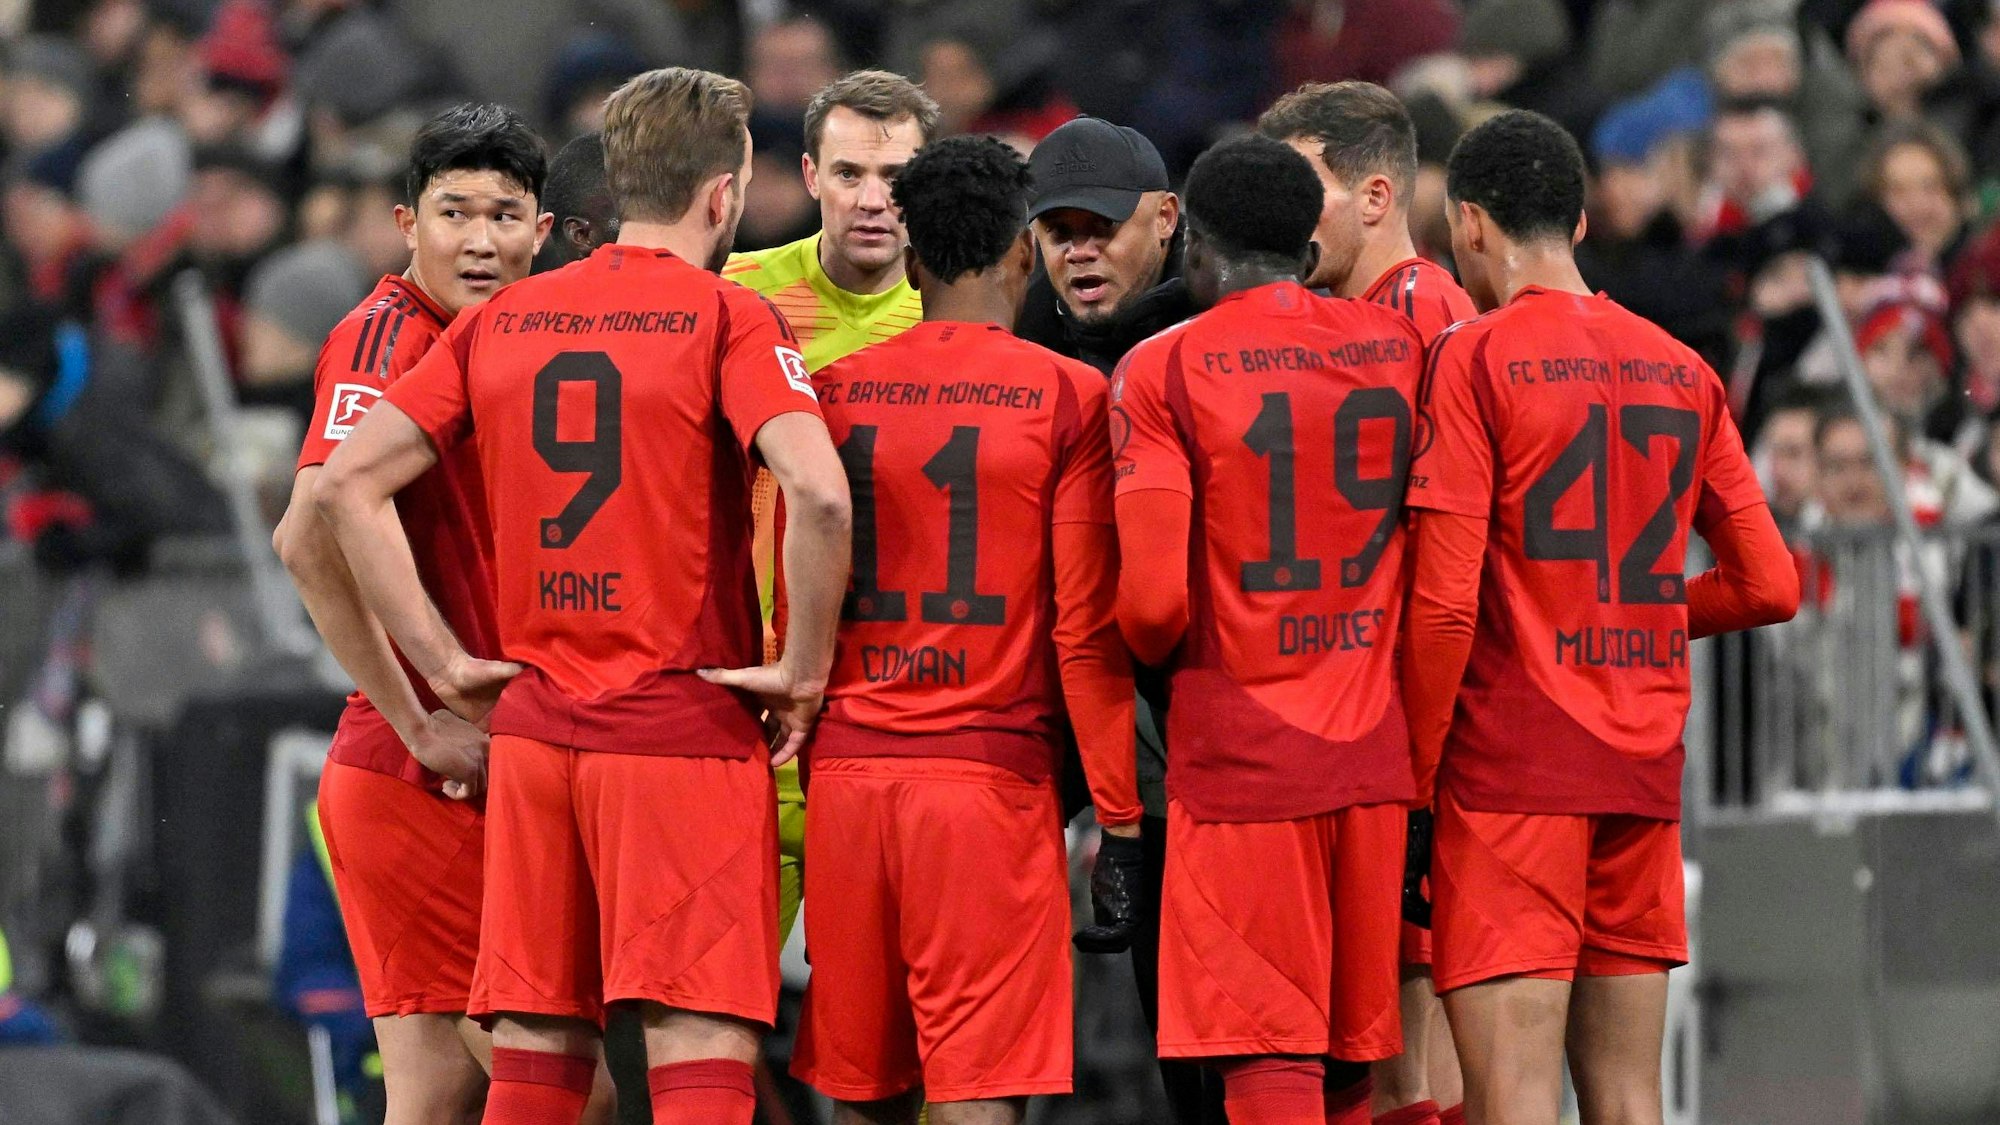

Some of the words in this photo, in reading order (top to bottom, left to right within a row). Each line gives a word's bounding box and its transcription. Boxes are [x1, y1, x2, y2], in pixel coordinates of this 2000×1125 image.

[493, 312, 518, 334] FC
[519, 311, 597, 334] BAYERN
[599, 311, 698, 334] MÜNCHEN
[1204, 353, 1232, 374] FC
[1507, 361, 1535, 385] FC
[818, 383, 842, 404] FC
[847, 381, 930, 405] BAYERN
[937, 381, 1043, 410] MÜNCHEN
[533, 351, 622, 549] 9
[1241, 387, 1413, 593] 19
[1523, 402, 1701, 604] 42
[836, 424, 1006, 626] 11
[540, 572, 622, 612] KANE
[861, 645, 966, 686] COMAN
